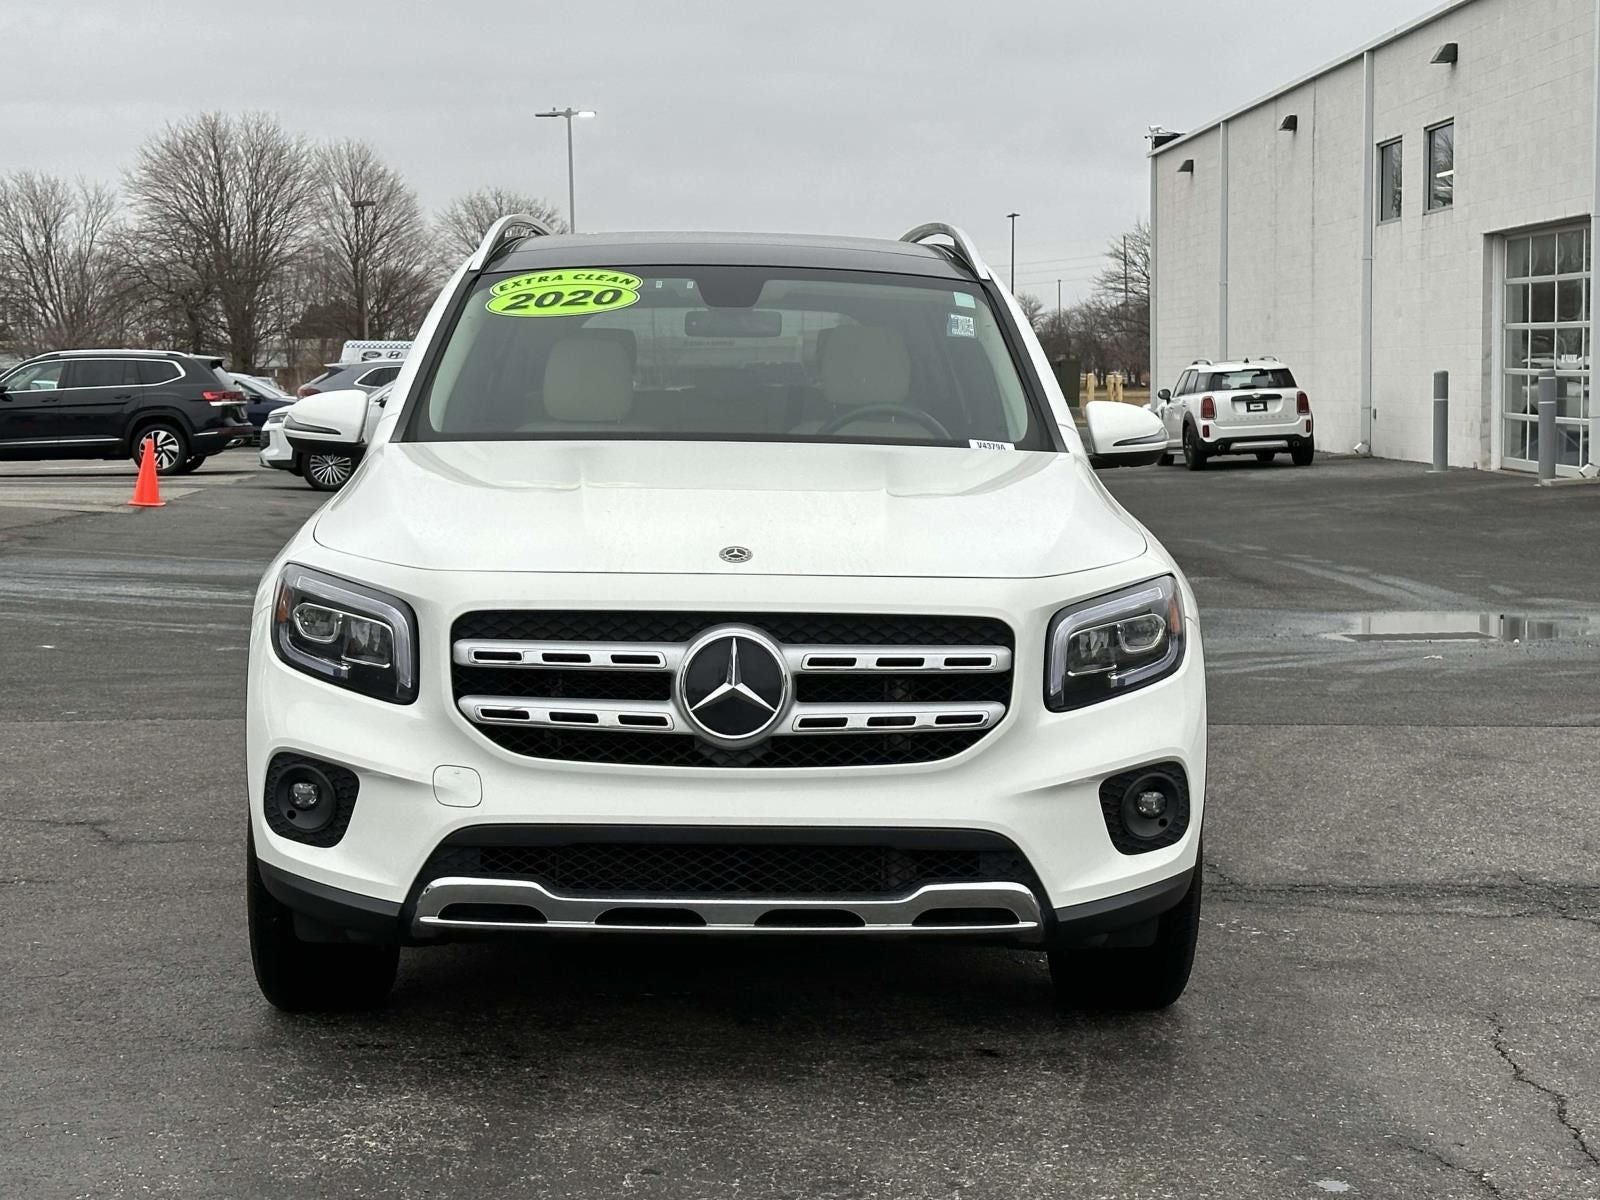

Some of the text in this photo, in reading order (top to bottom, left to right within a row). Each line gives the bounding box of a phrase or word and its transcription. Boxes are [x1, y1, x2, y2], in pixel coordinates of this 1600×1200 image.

[499, 273, 635, 292] EXTRA CLEAN
[501, 289, 623, 312] 2020
